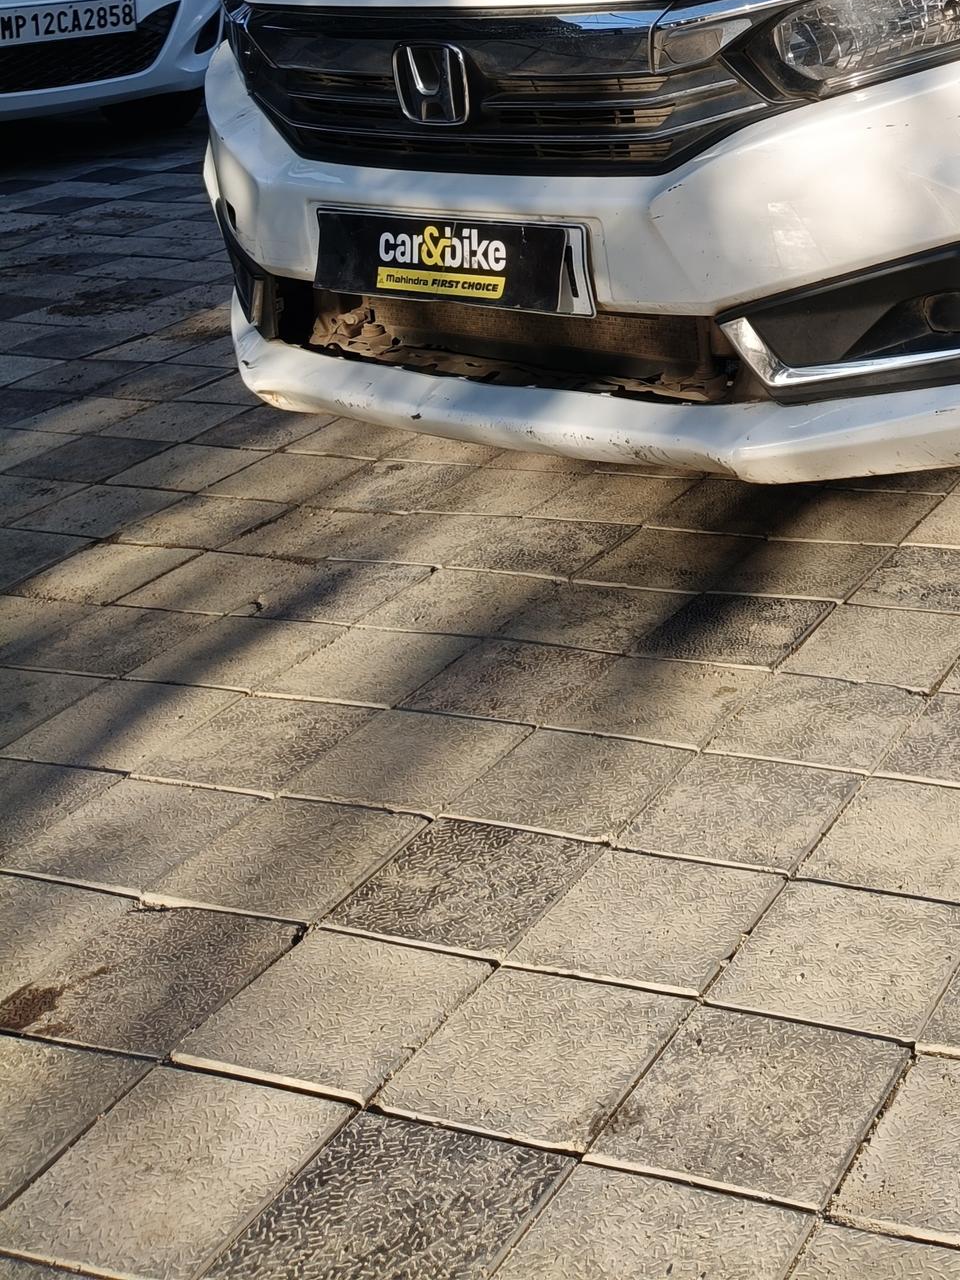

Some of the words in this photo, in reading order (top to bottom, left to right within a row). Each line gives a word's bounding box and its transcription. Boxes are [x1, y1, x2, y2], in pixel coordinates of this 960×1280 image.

[0, 4, 133, 40] MP12CA2858
[379, 225, 507, 271] car&bike
[385, 274, 429, 286] Mahindra
[431, 278, 461, 289] FIRST
[461, 281, 499, 292] CHOICE
